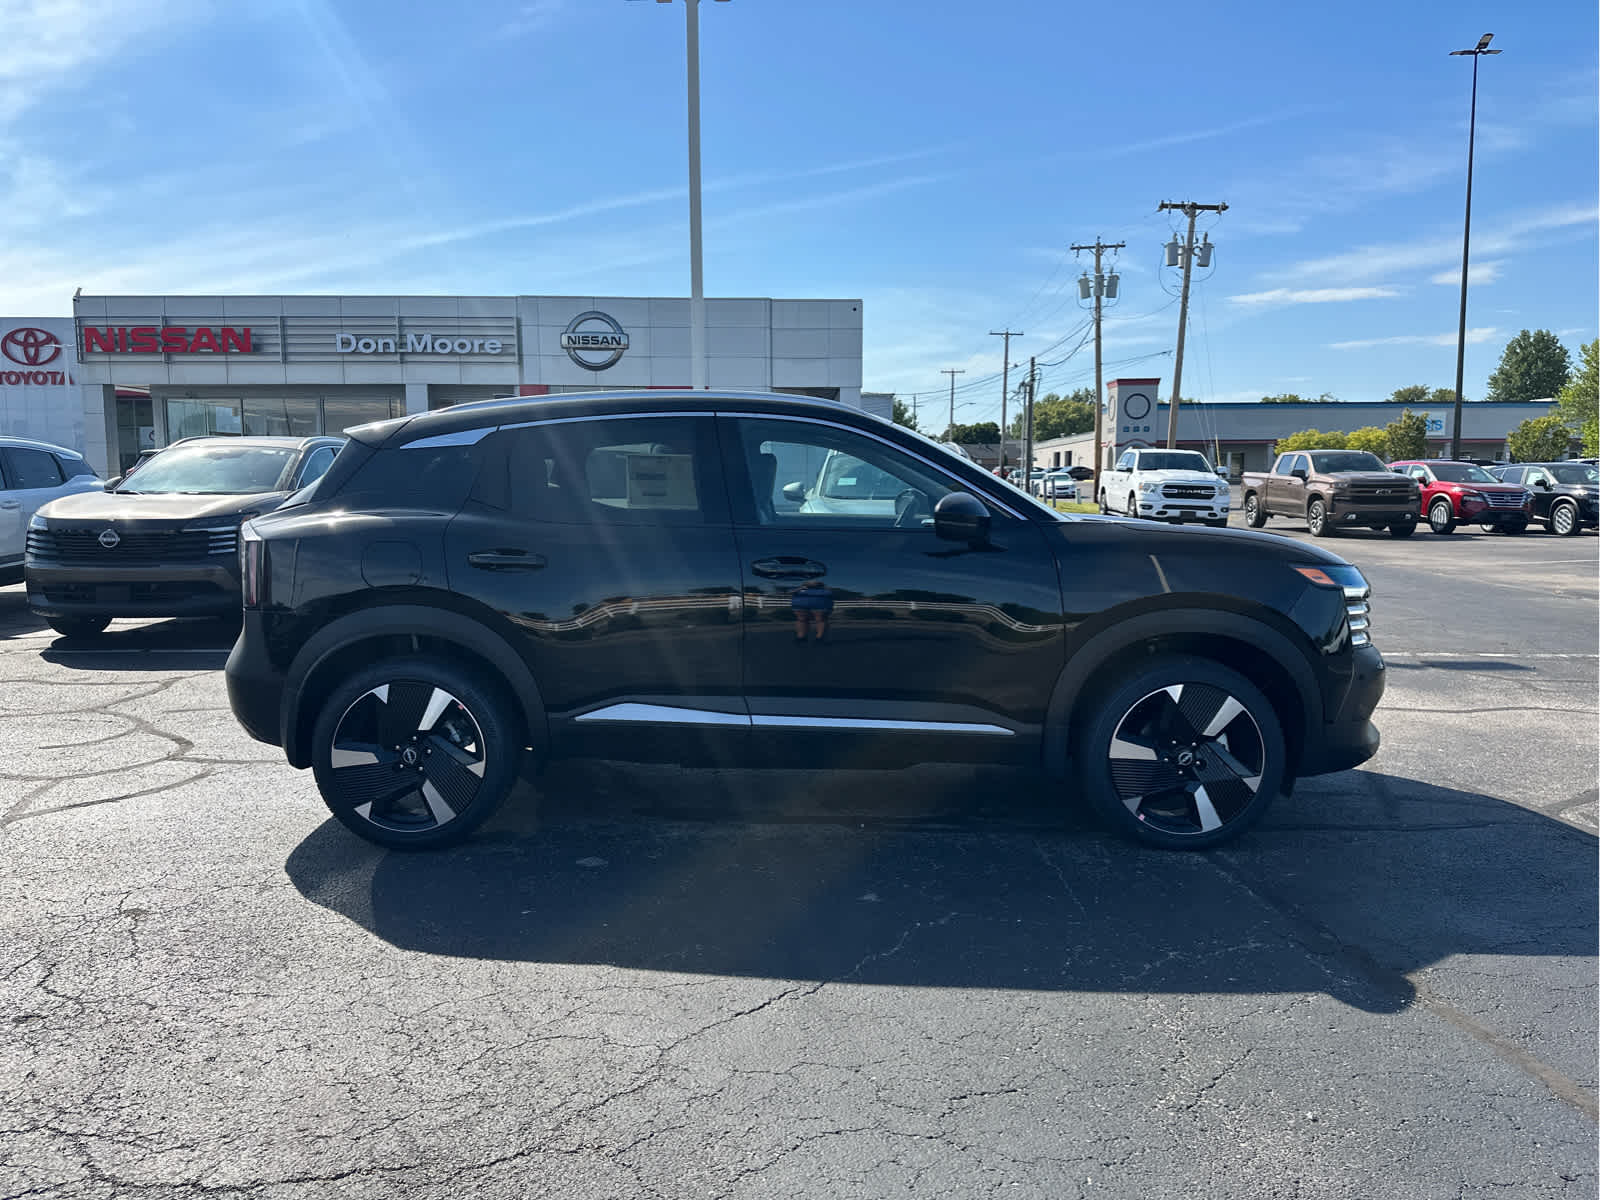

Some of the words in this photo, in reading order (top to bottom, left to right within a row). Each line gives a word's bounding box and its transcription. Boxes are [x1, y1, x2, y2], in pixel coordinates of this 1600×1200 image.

[84, 328, 252, 352] NISSAN
[336, 333, 396, 353] Don
[406, 333, 502, 353] Moore
[567, 335, 622, 345] NISSAN
